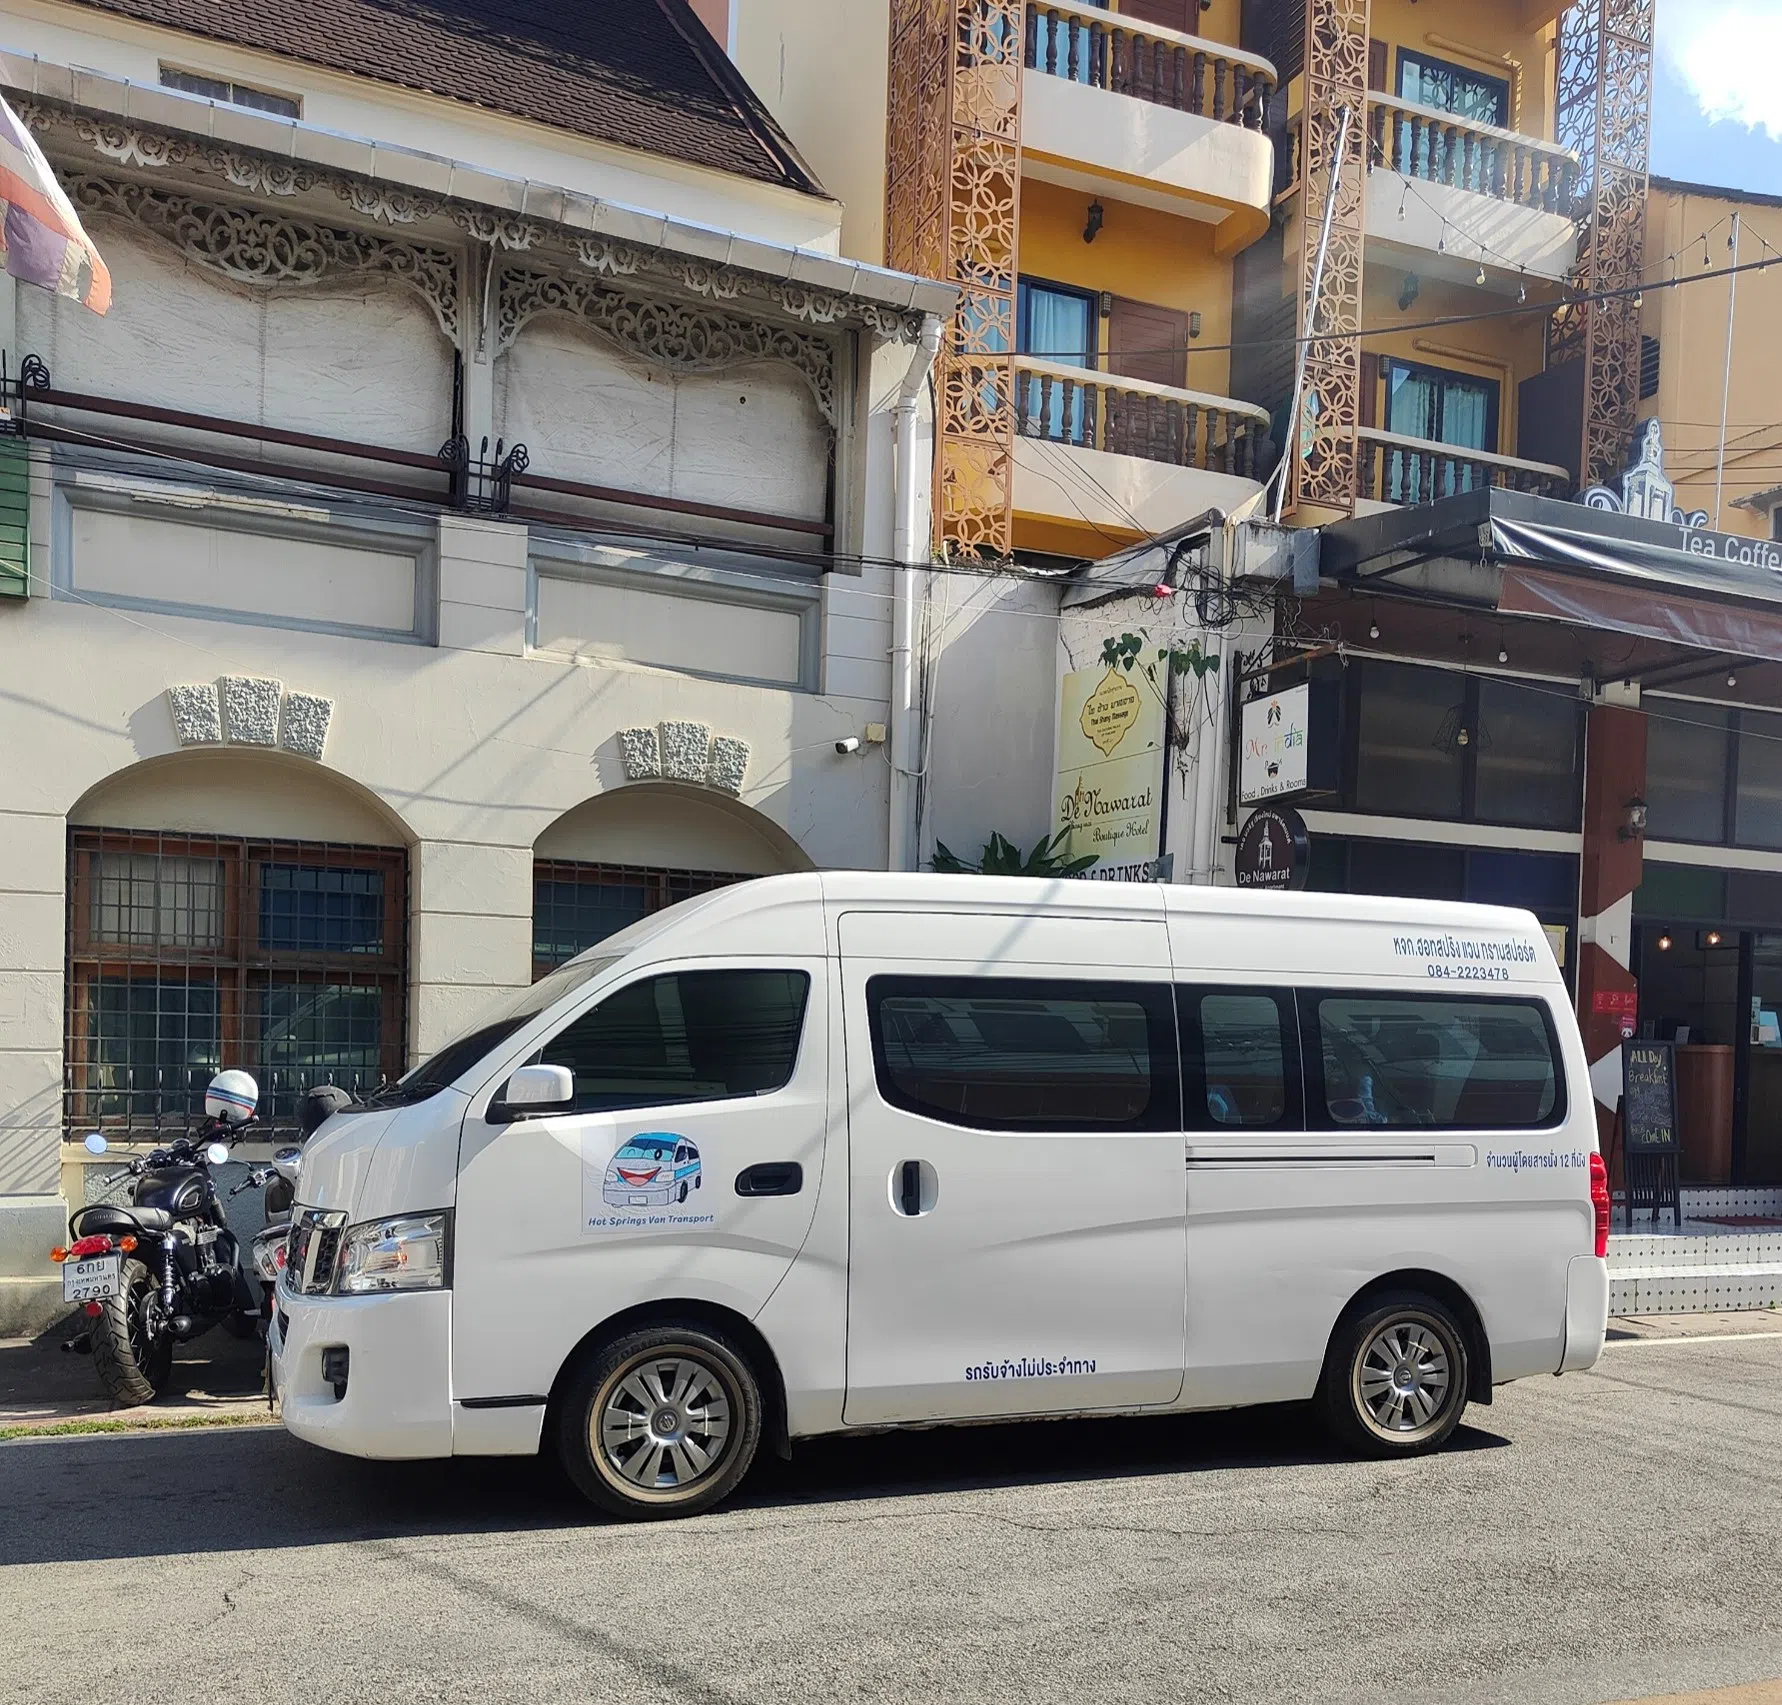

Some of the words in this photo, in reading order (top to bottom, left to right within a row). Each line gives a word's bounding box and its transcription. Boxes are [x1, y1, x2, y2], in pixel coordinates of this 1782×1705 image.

[1679, 527, 1716, 559] Tea
[1724, 537, 1782, 571] Coffe
[1261, 781, 1278, 797] Drinks
[1287, 777, 1306, 790] Rooms
[1061, 794, 1081, 822] De
[1084, 786, 1153, 818] Nawarat
[1093, 827, 1124, 848] Boutique
[1126, 818, 1150, 838] Hotel
[1099, 861, 1149, 883] DRINKS
[1240, 871, 1251, 884] De
[1252, 867, 1290, 882] Nawarat
[1461, 940, 1480, 960] แวน
[1427, 964, 1509, 980] 084-2223478
[1628, 1069, 1668, 1085] Breakfast
[1661, 1128, 1671, 1143] IN
[1560, 1154, 1569, 1168] 12
[588, 1217, 607, 1226] Hot
[608, 1216, 647, 1227] Springs
[648, 1215, 666, 1224] Van
[668, 1213, 715, 1225] Transport
[72, 1284, 111, 1299] 2790
[965, 1355, 1096, 1380] รถรับจ้างไม่ประจำทาง
